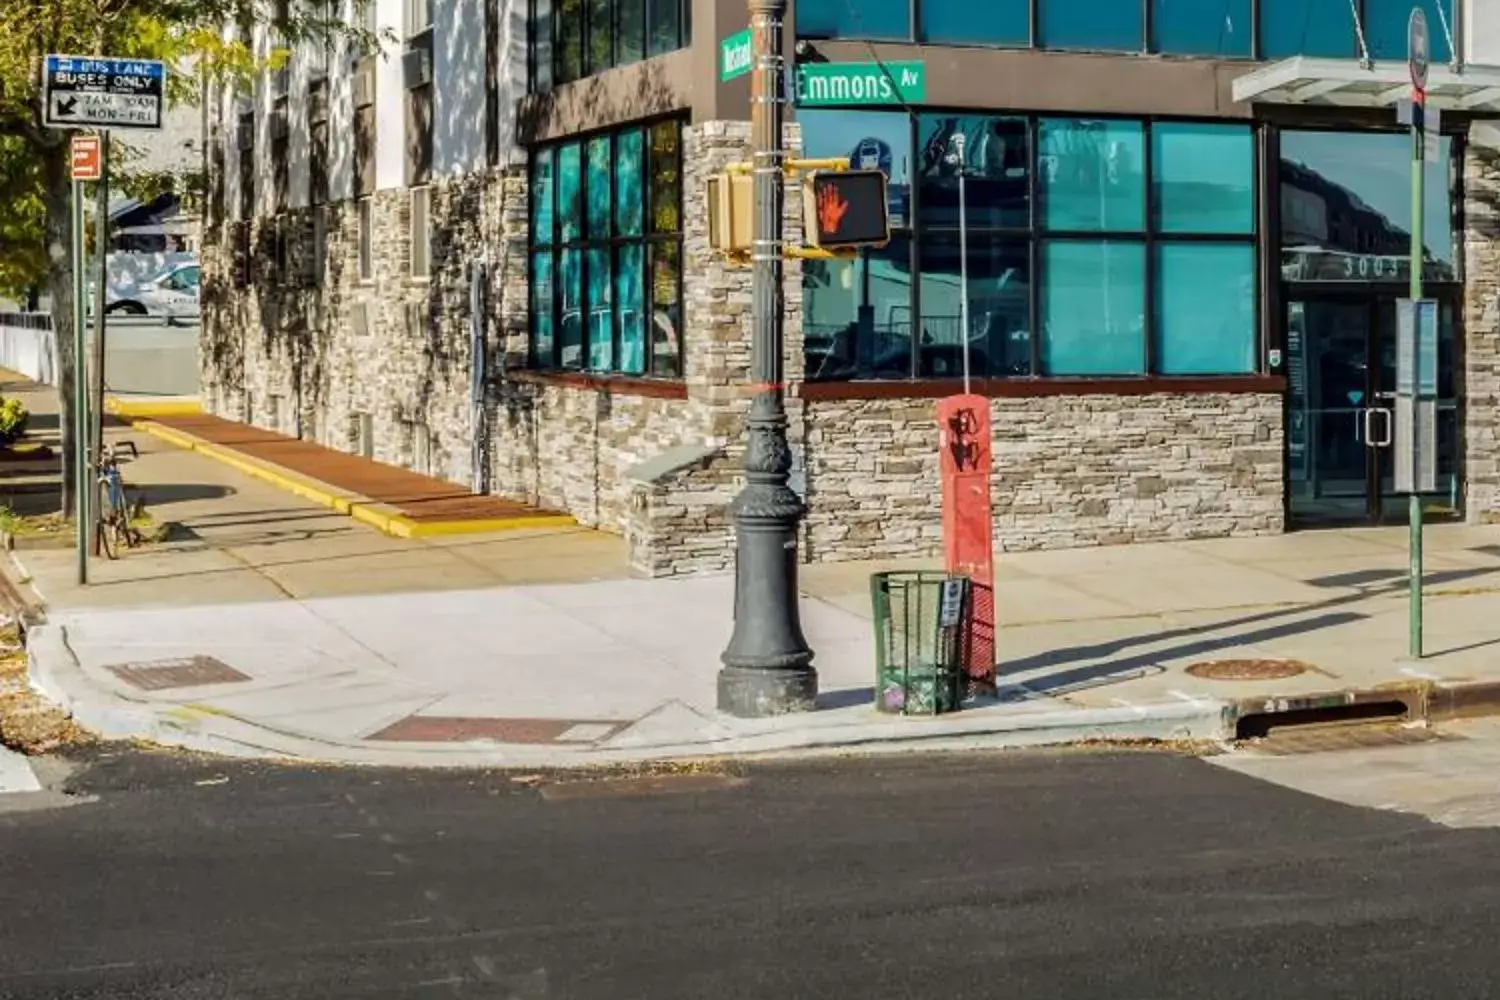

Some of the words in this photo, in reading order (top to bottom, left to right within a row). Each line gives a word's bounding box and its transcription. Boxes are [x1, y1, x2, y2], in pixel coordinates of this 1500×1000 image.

[81, 61, 109, 73] BUS
[115, 63, 153, 75] LANE
[56, 72, 107, 85] BUSES
[114, 75, 153, 88] ONLY
[796, 69, 891, 99] Emmons
[901, 68, 919, 86] Av
[1343, 257, 1399, 276] 3003
